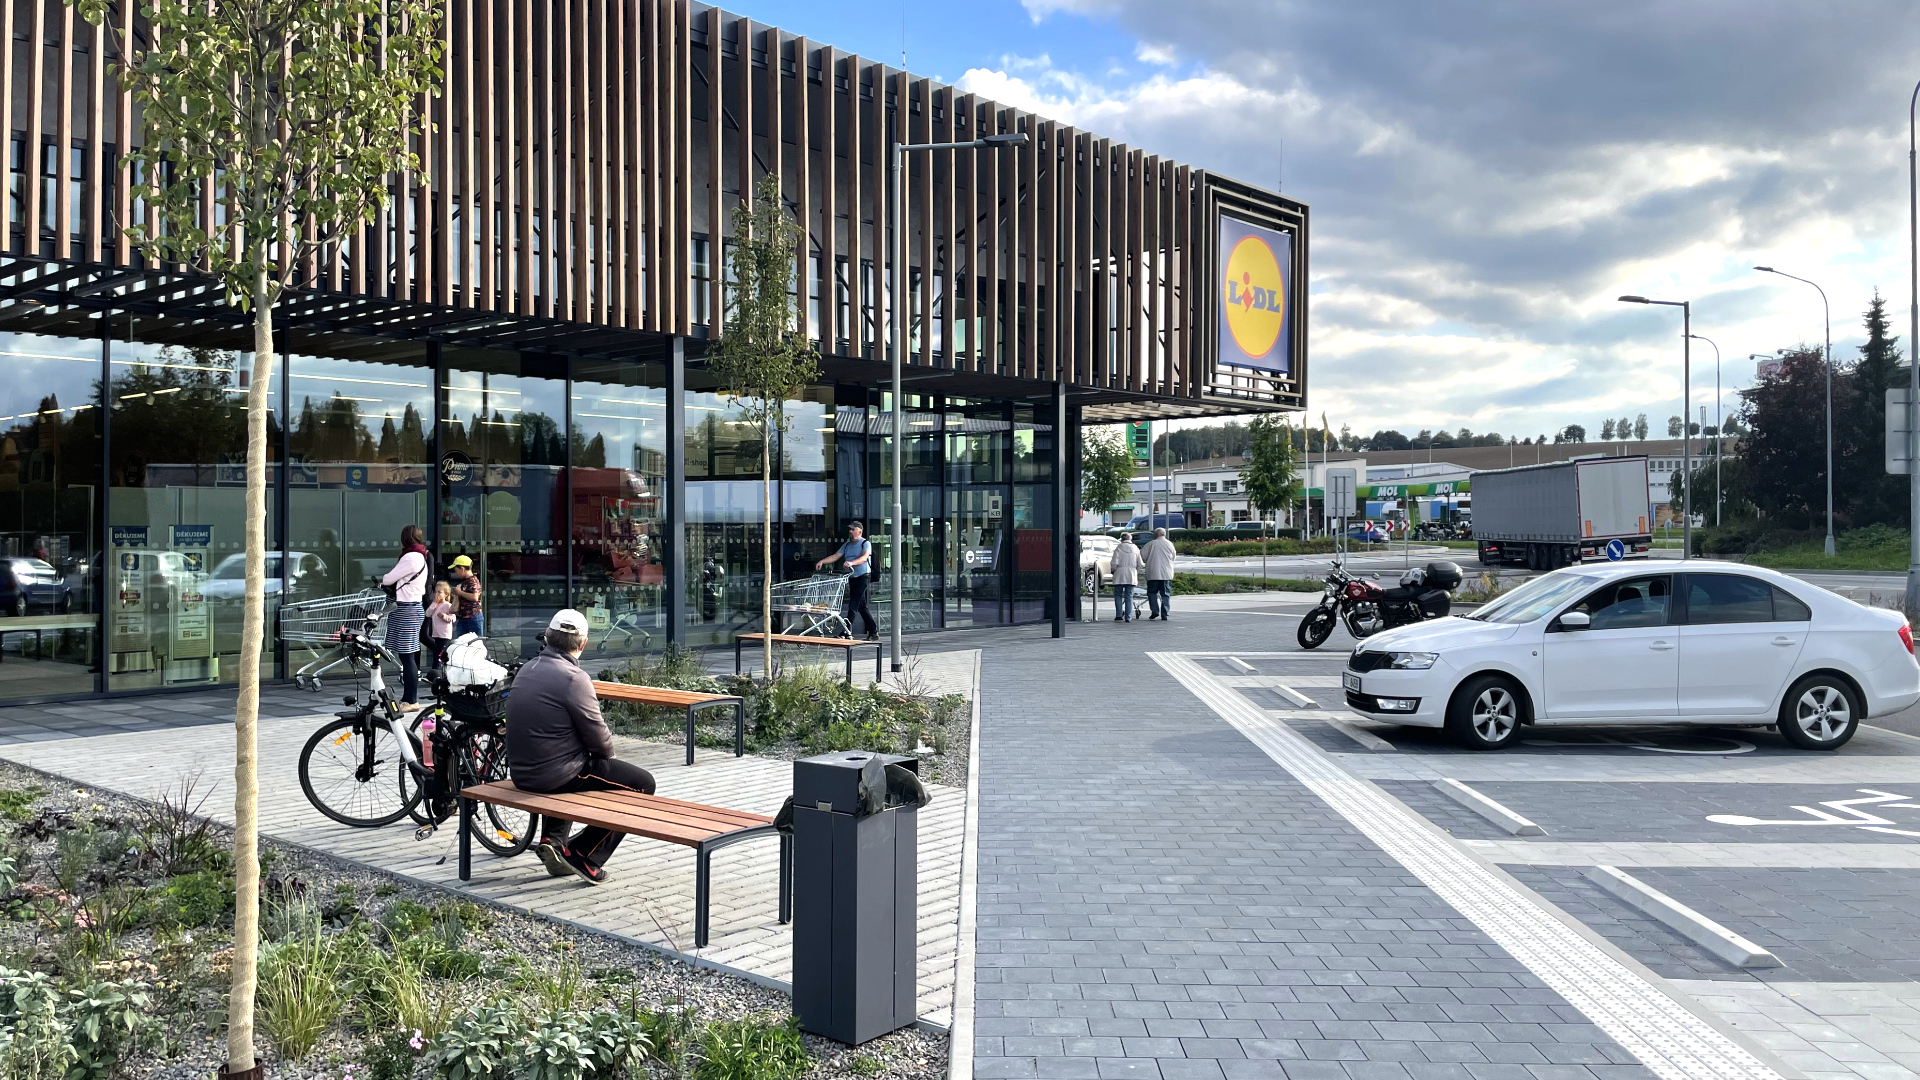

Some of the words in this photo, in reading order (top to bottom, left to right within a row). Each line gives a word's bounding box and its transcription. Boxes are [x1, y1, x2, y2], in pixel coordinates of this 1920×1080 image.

[1228, 271, 1280, 313] LIDL
[1377, 486, 1398, 496] MOL
[1435, 482, 1453, 494] MOL
